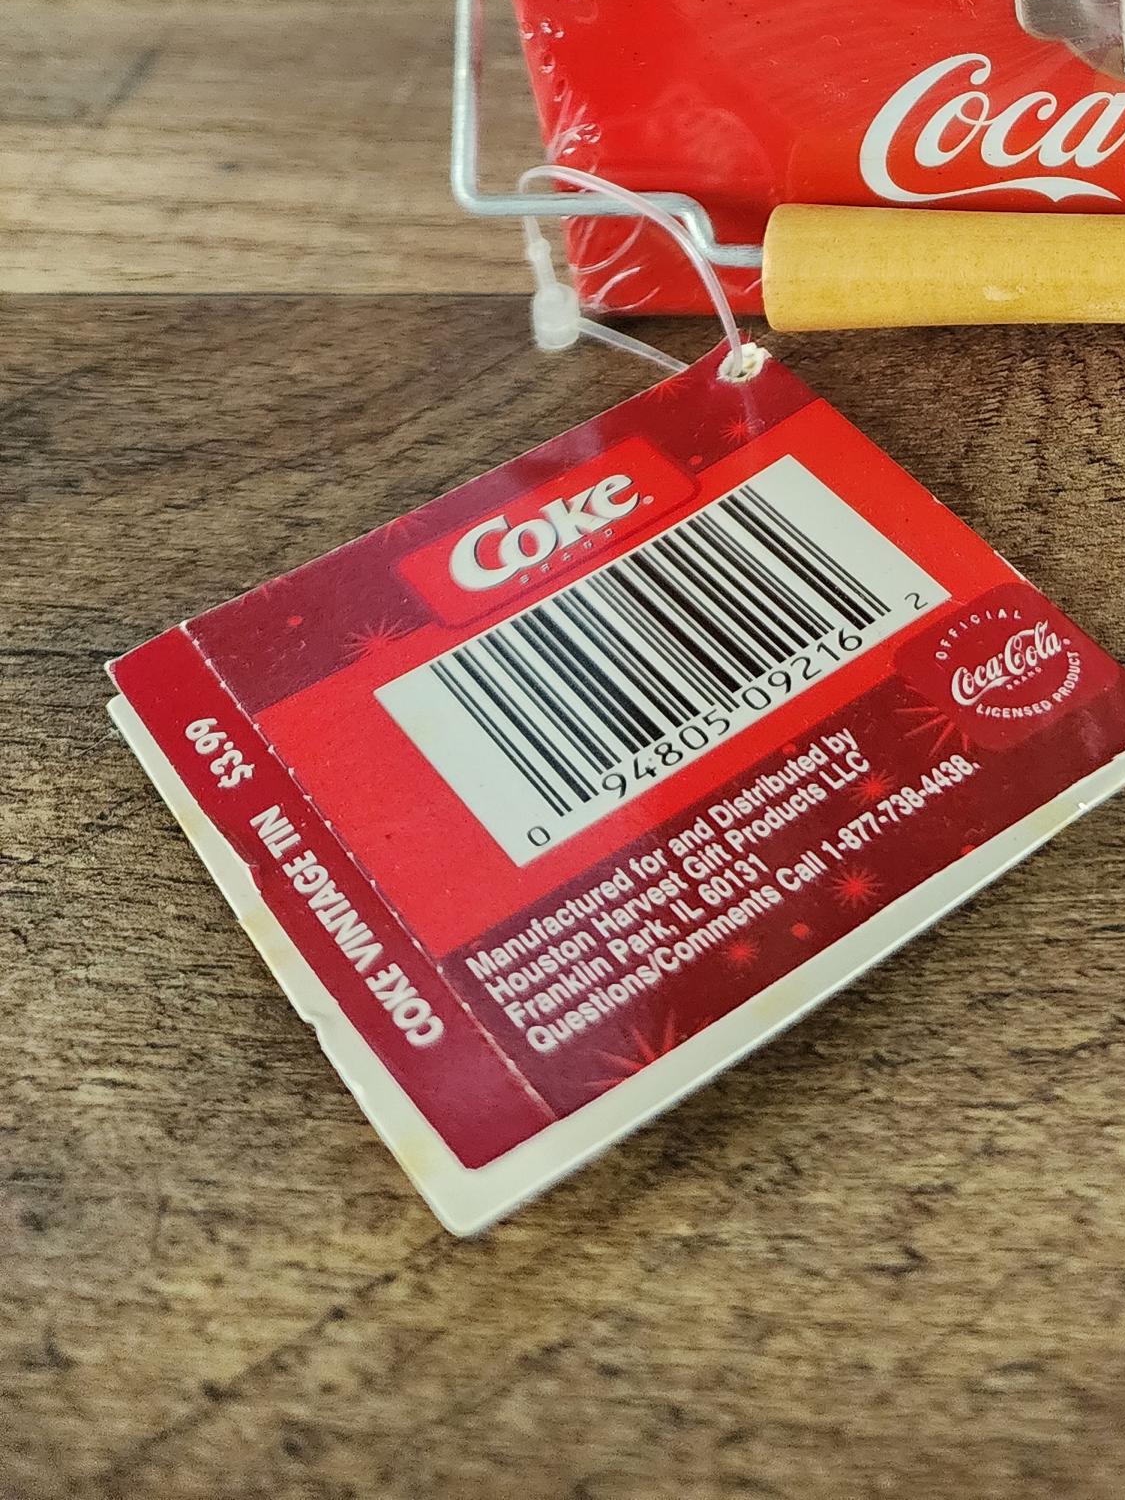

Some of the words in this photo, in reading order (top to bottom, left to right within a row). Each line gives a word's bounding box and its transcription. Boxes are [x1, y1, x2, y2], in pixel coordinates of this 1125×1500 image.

[450, 474, 640, 591] Coke
[935, 608, 1022, 660] OFFICIAL
[951, 619, 1062, 706] Coca-Cola
[975, 699, 1054, 719] LICENSED
[1052, 651, 1081, 702] PRODUCT
[185, 717, 256, 788] $3.99
[527, 825, 551, 847] 0
[904, 592, 928, 610] 2
[249, 804, 301, 859] TIN
[465, 867, 634, 980] Manufactured
[629, 848, 668, 880] for
[668, 816, 715, 858] and
[707, 742, 829, 830] Distributed
[821, 727, 859, 753] by
[485, 930, 597, 1004] Houston
[590, 870, 688, 938] Harvest
[682, 841, 732, 880] Gift
[724, 781, 828, 853] Products
[819, 750, 870, 791] LLC
[282, 850, 384, 973] VINTAGE
[503, 956, 613, 1029] Franklin
[606, 918, 681, 964] Park,
[669, 900, 705, 923] IL
[698, 852, 770, 907] 60131
[525, 885, 784, 1054] Questions/Comments
[775, 850, 828, 892] Call
[821, 753, 981, 861] 1-877-738-4438.
[366, 963, 444, 1047] COKE
